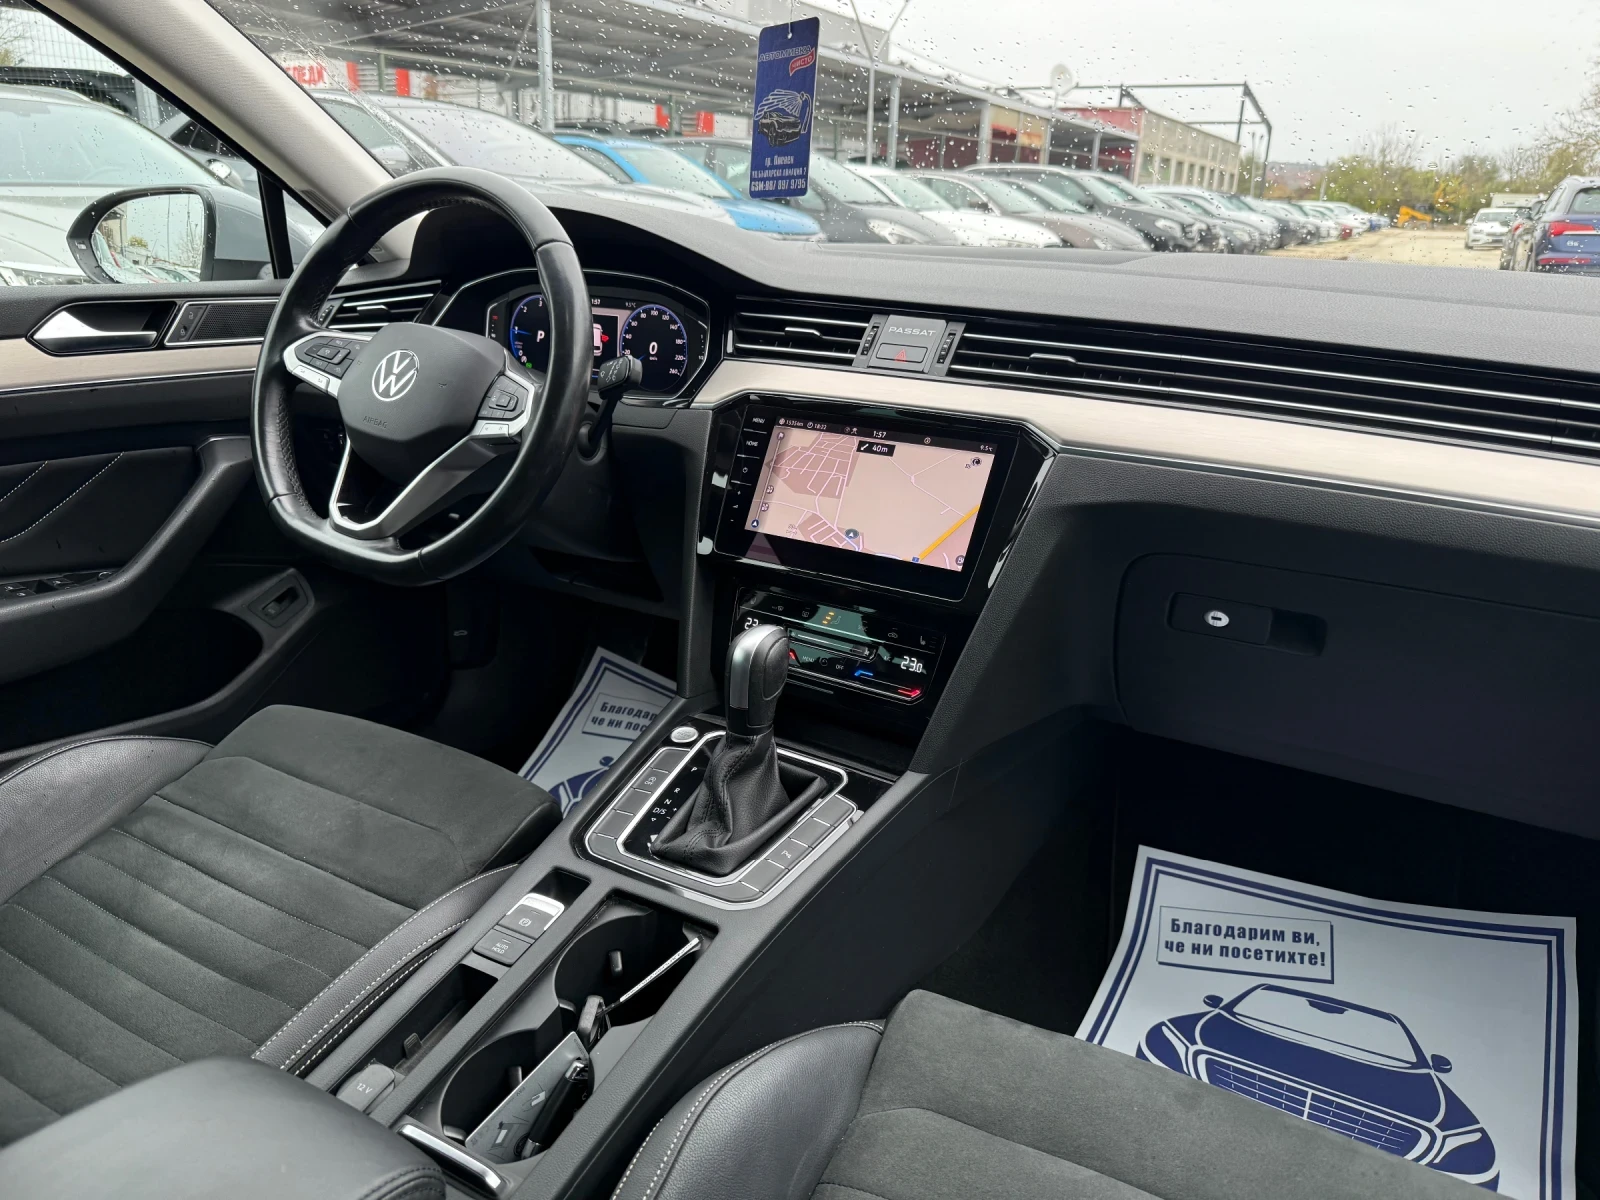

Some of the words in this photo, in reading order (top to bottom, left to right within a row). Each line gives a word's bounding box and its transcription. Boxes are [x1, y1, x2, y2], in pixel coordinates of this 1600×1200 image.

[758, 45, 812, 62] АВТОМИВКА
[791, 56, 812, 68] ЧИСТО
[790, 178, 806, 189] 9795
[536, 330, 545, 342] P
[888, 326, 936, 336] PASSAT
[649, 341, 658, 355] 0
[363, 416, 388, 429] AIRBAG
[873, 430, 887, 438] 1:57
[872, 444, 888, 453] 40m
[900, 655, 923, 674] 23.0
[591, 716, 606, 726] че
[607, 718, 623, 729] ни
[652, 807, 667, 815] D/S
[1170, 917, 1285, 942] Благодарим
[1291, 931, 1320, 946] ви,
[491, 946, 505, 954] HOLD
[496, 942, 509, 951] AUTO
[1164, 940, 1185, 953] че
[1191, 943, 1213, 956] ни
[1219, 945, 1326, 966] посетихте!
[356, 1082, 366, 1092] 12
[365, 1086, 373, 1094] V
